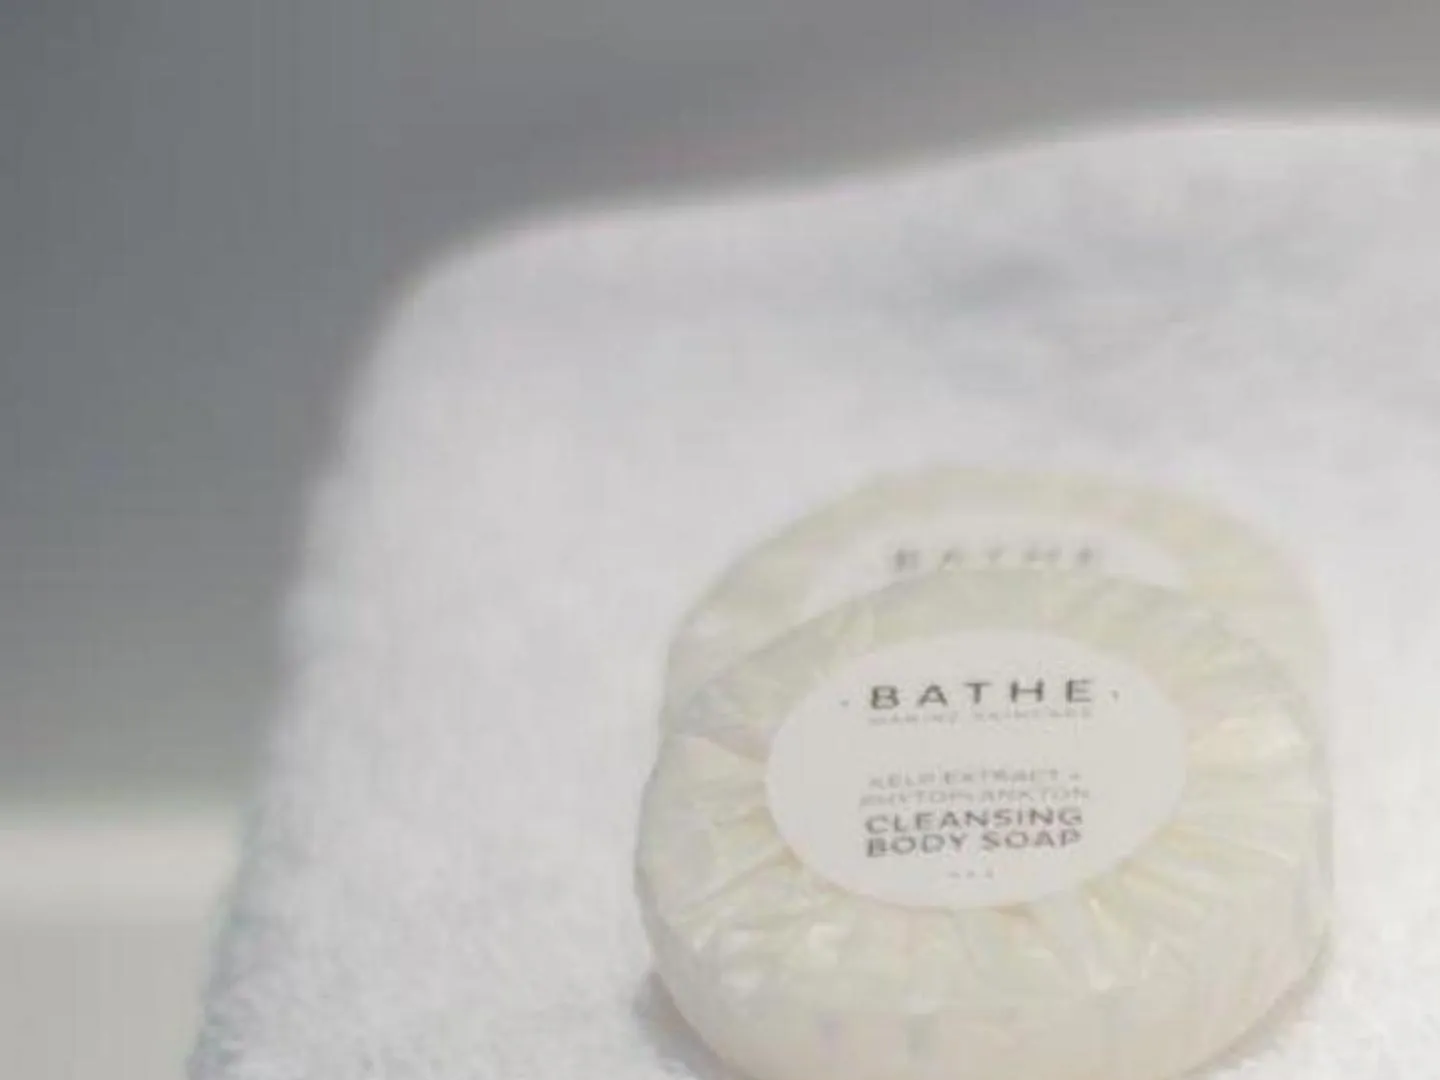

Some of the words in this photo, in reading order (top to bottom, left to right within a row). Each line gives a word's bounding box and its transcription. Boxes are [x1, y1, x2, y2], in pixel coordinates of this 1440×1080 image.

[869, 678, 1094, 710] BATHE
[863, 804, 1085, 835] CLEANSING
[865, 832, 969, 859] BODY
[980, 827, 1083, 853] SOAP
